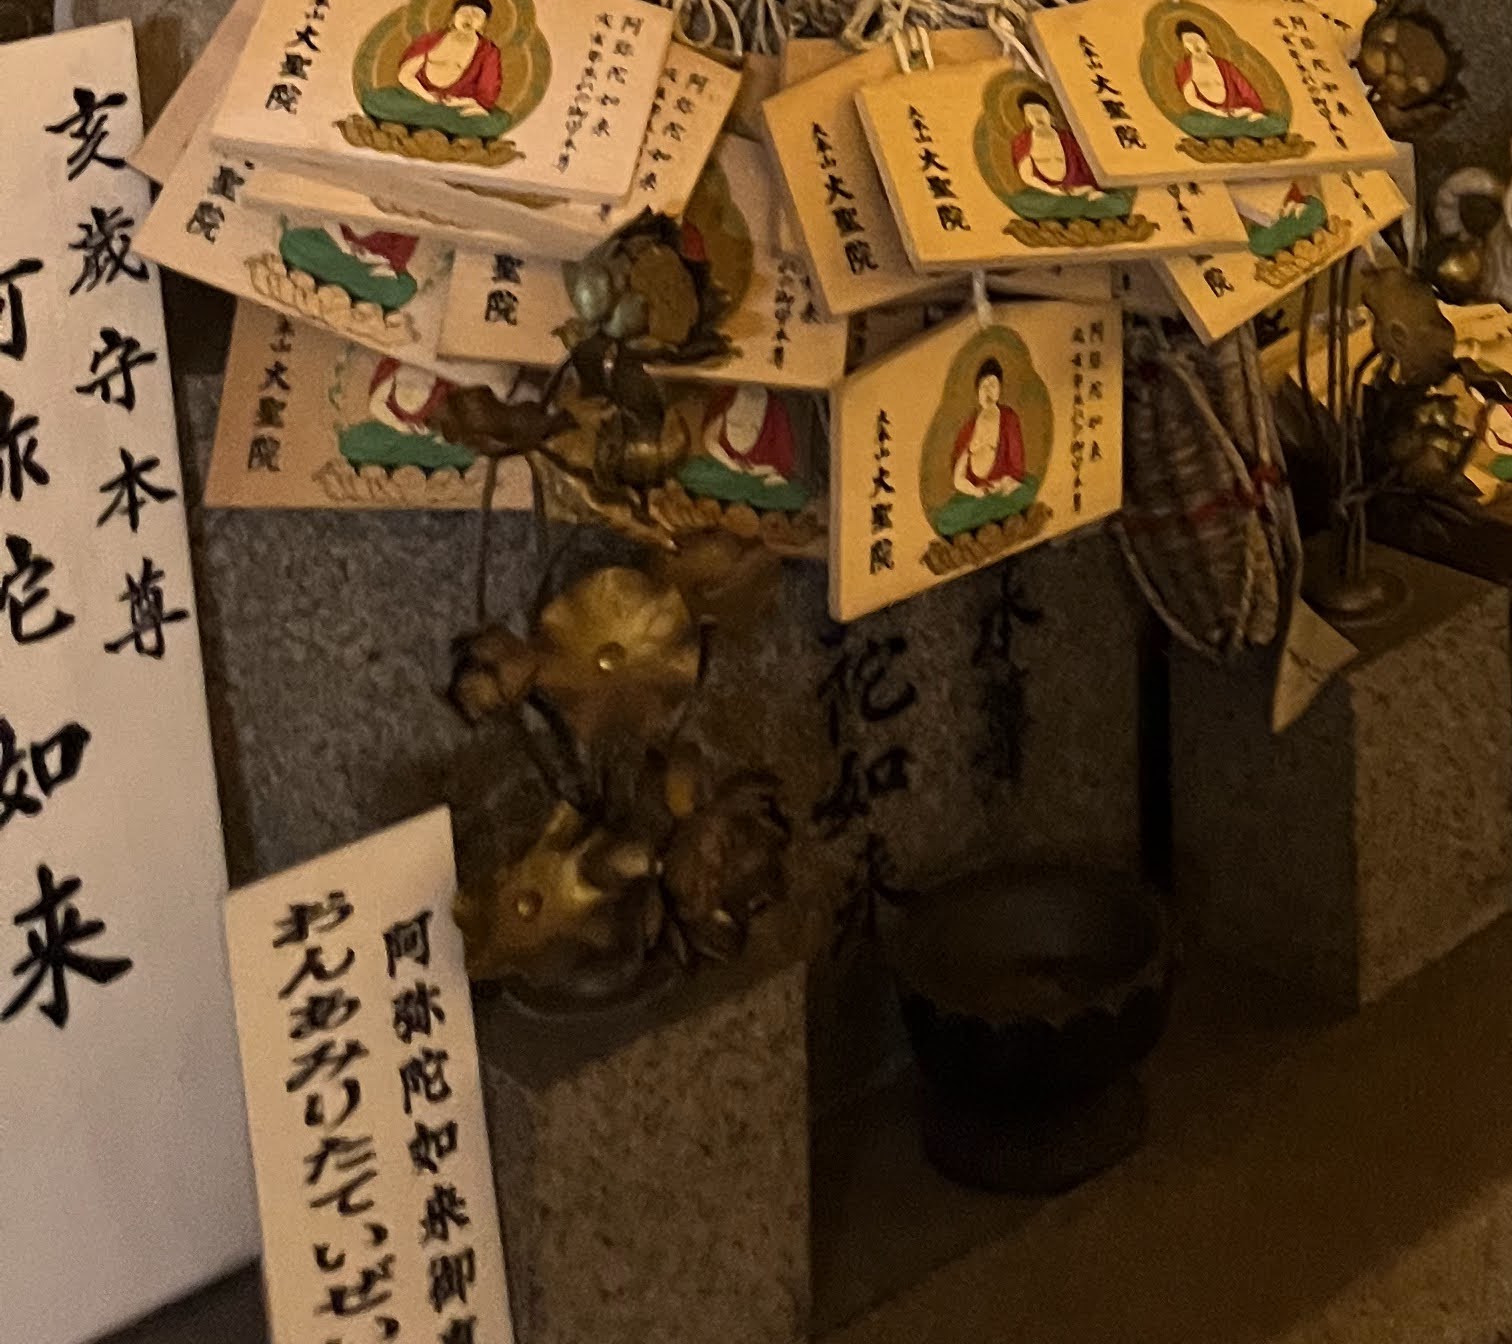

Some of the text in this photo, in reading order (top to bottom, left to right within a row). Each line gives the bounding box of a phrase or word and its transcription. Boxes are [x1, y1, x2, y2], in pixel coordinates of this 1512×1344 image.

[46, 87, 189, 660] 亥歳守本尊
